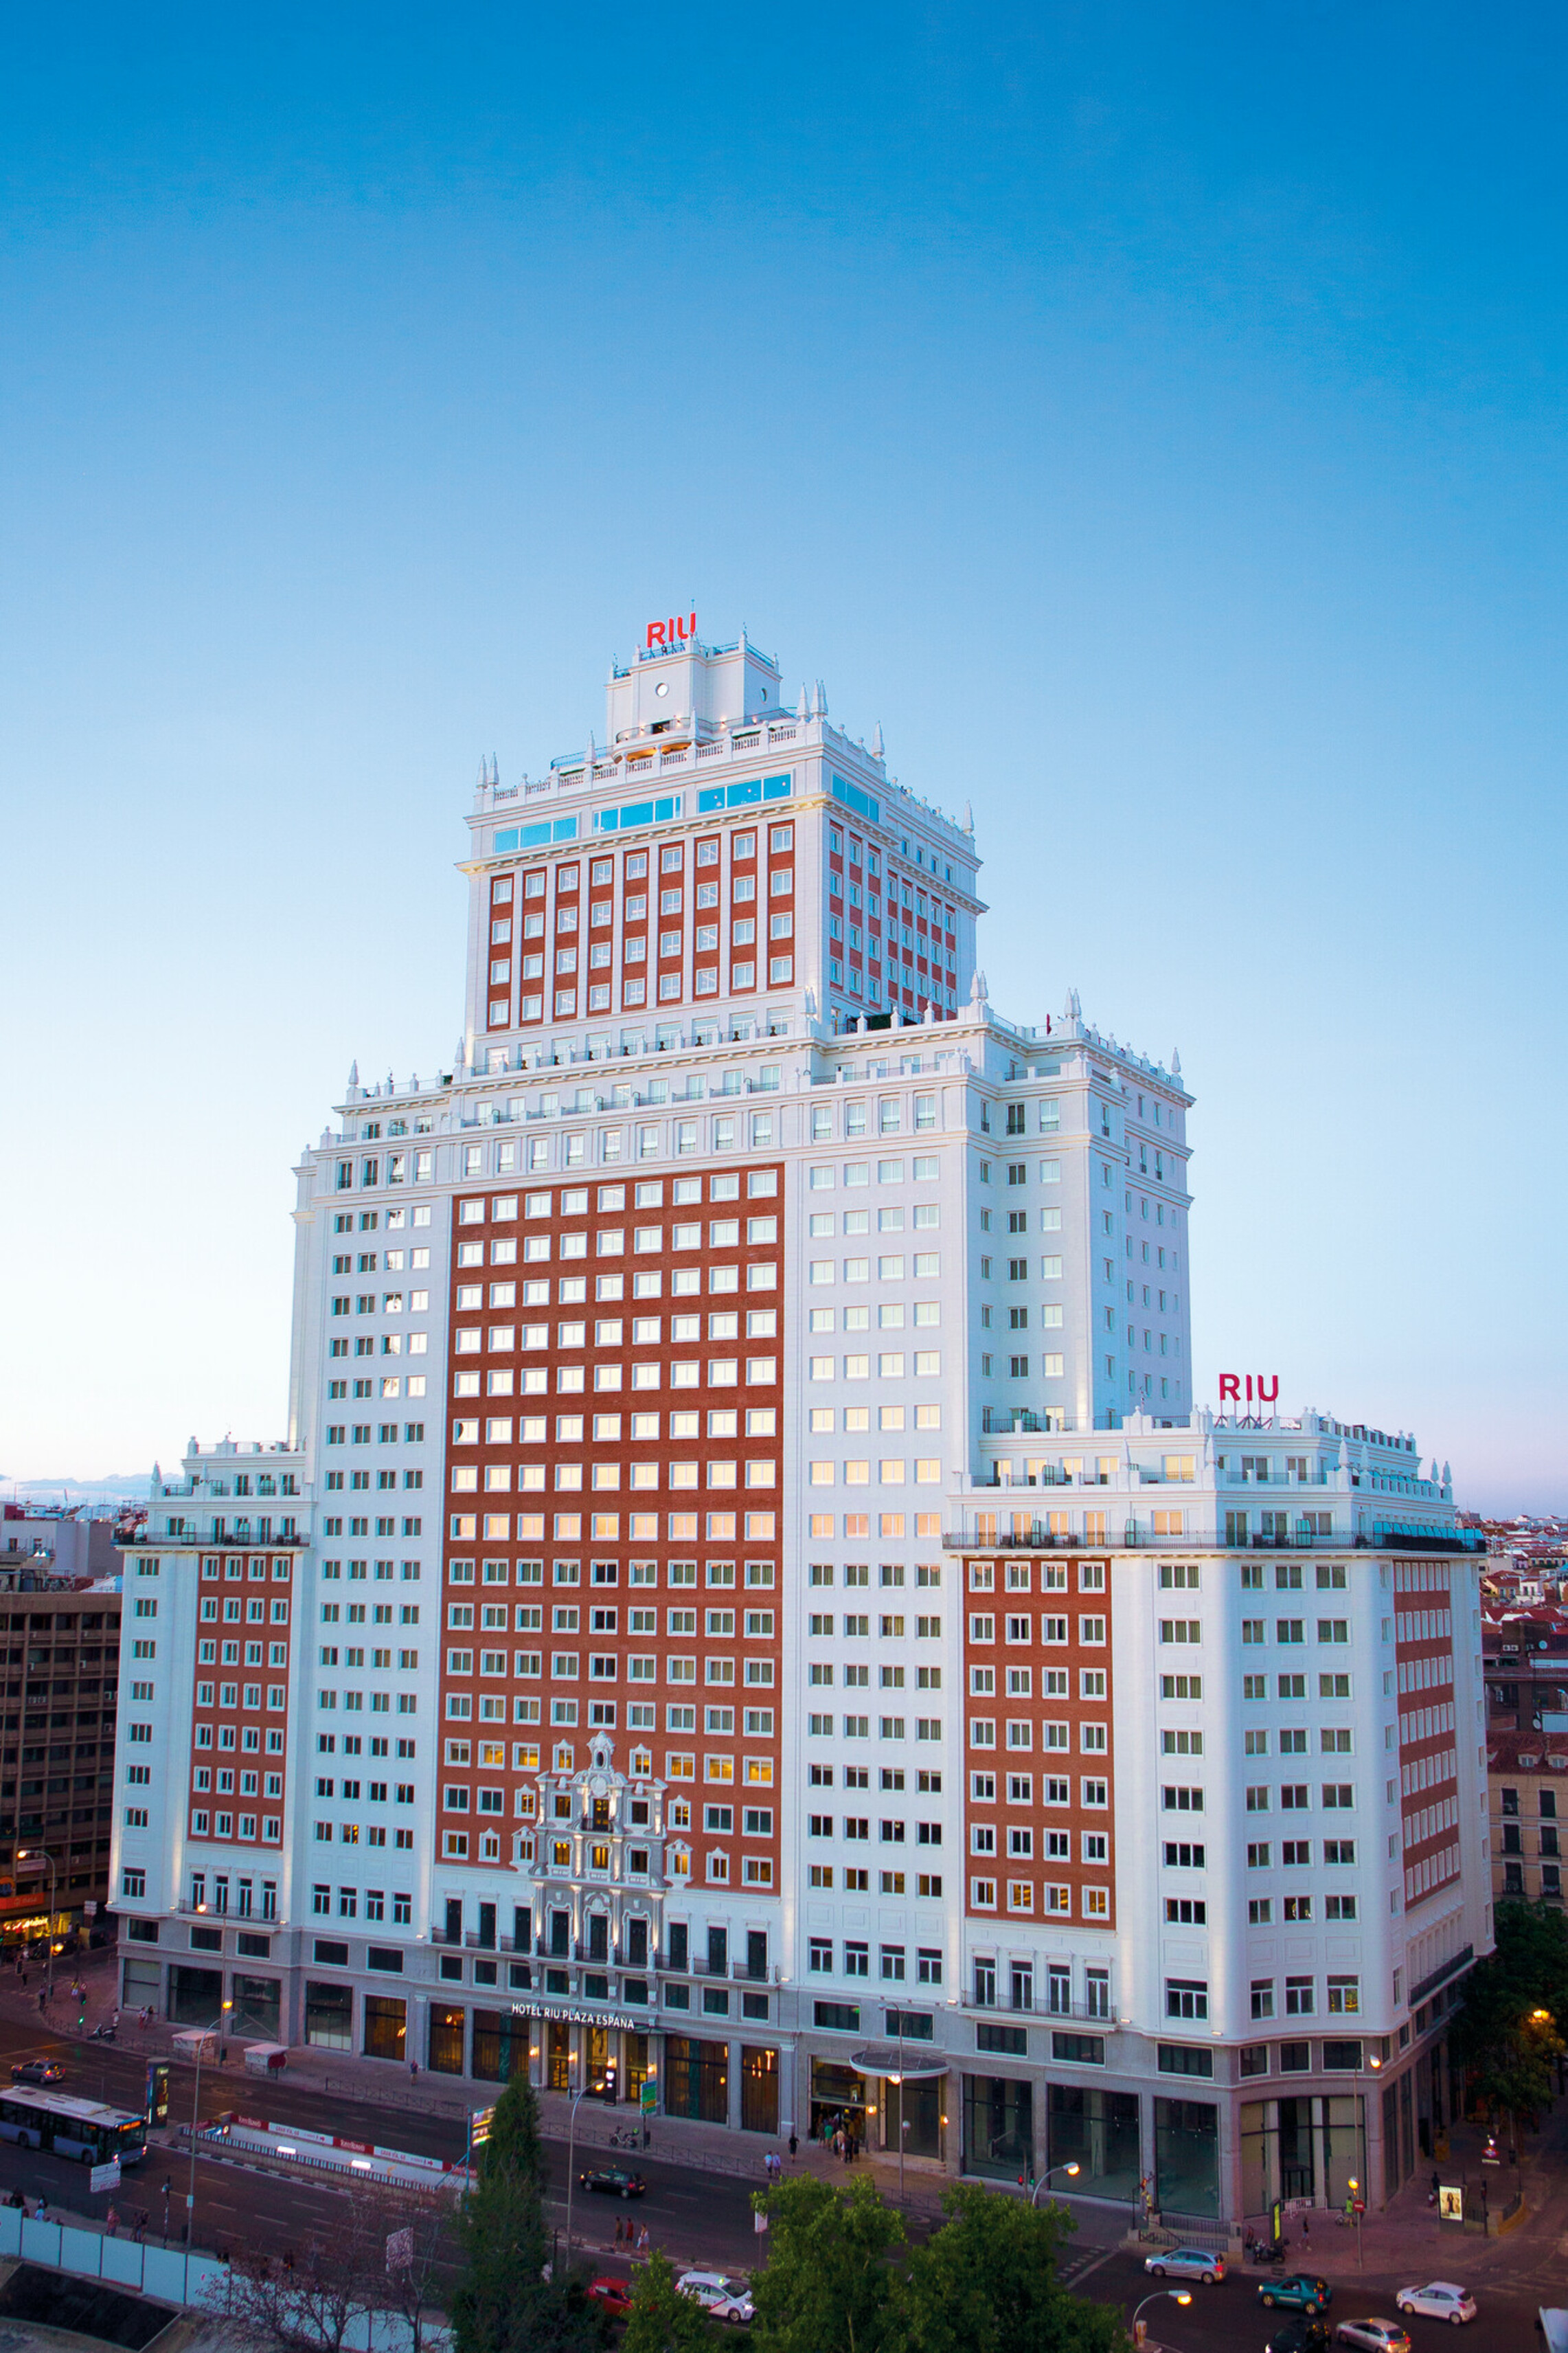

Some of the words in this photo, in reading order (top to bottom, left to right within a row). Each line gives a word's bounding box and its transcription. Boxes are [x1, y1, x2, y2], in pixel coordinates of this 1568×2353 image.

[647, 612, 696, 648] RIU
[1219, 1373, 1279, 1401] RIU
[512, 2003, 541, 2017] HOTEL
[544, 2007, 560, 2019] RIU
[563, 2009, 593, 2025] PLAZA
[596, 2014, 635, 2029] ESPAÑA
